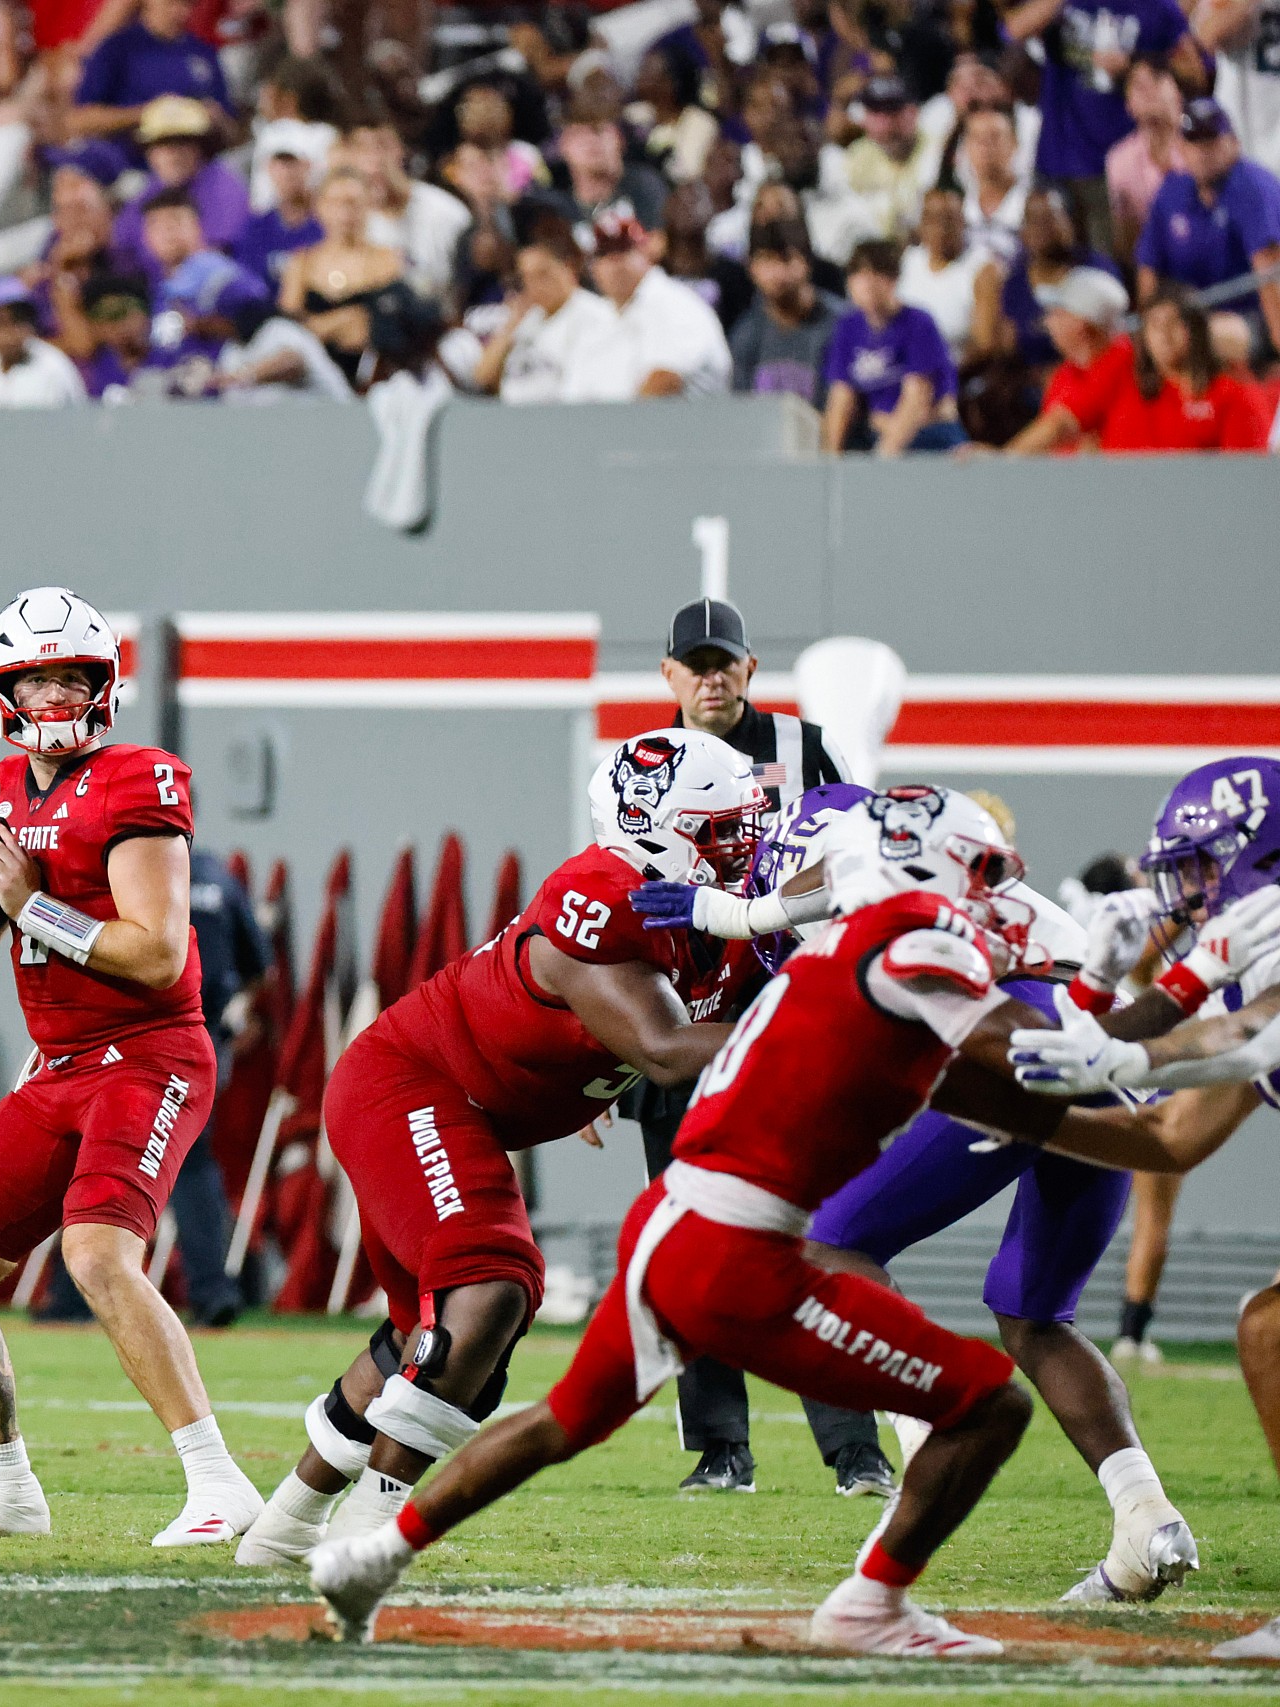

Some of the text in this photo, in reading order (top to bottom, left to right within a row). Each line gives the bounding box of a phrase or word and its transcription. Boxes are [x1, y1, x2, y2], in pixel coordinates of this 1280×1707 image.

[40, 642, 58, 653] HTT
[643, 752, 664, 763] STATE
[75, 768, 92, 797] C
[153, 764, 179, 806] 2
[1211, 769, 1270, 818] 47
[18, 825, 60, 850] STATE
[556, 890, 612, 950] 52
[685, 987, 723, 1022] STATE
[687, 972, 790, 1110] 0
[138, 1074, 190, 1179] WOLFPACK
[407, 1106, 465, 1222] WOLFPACK
[793, 1295, 943, 1392] WOLFPACK
